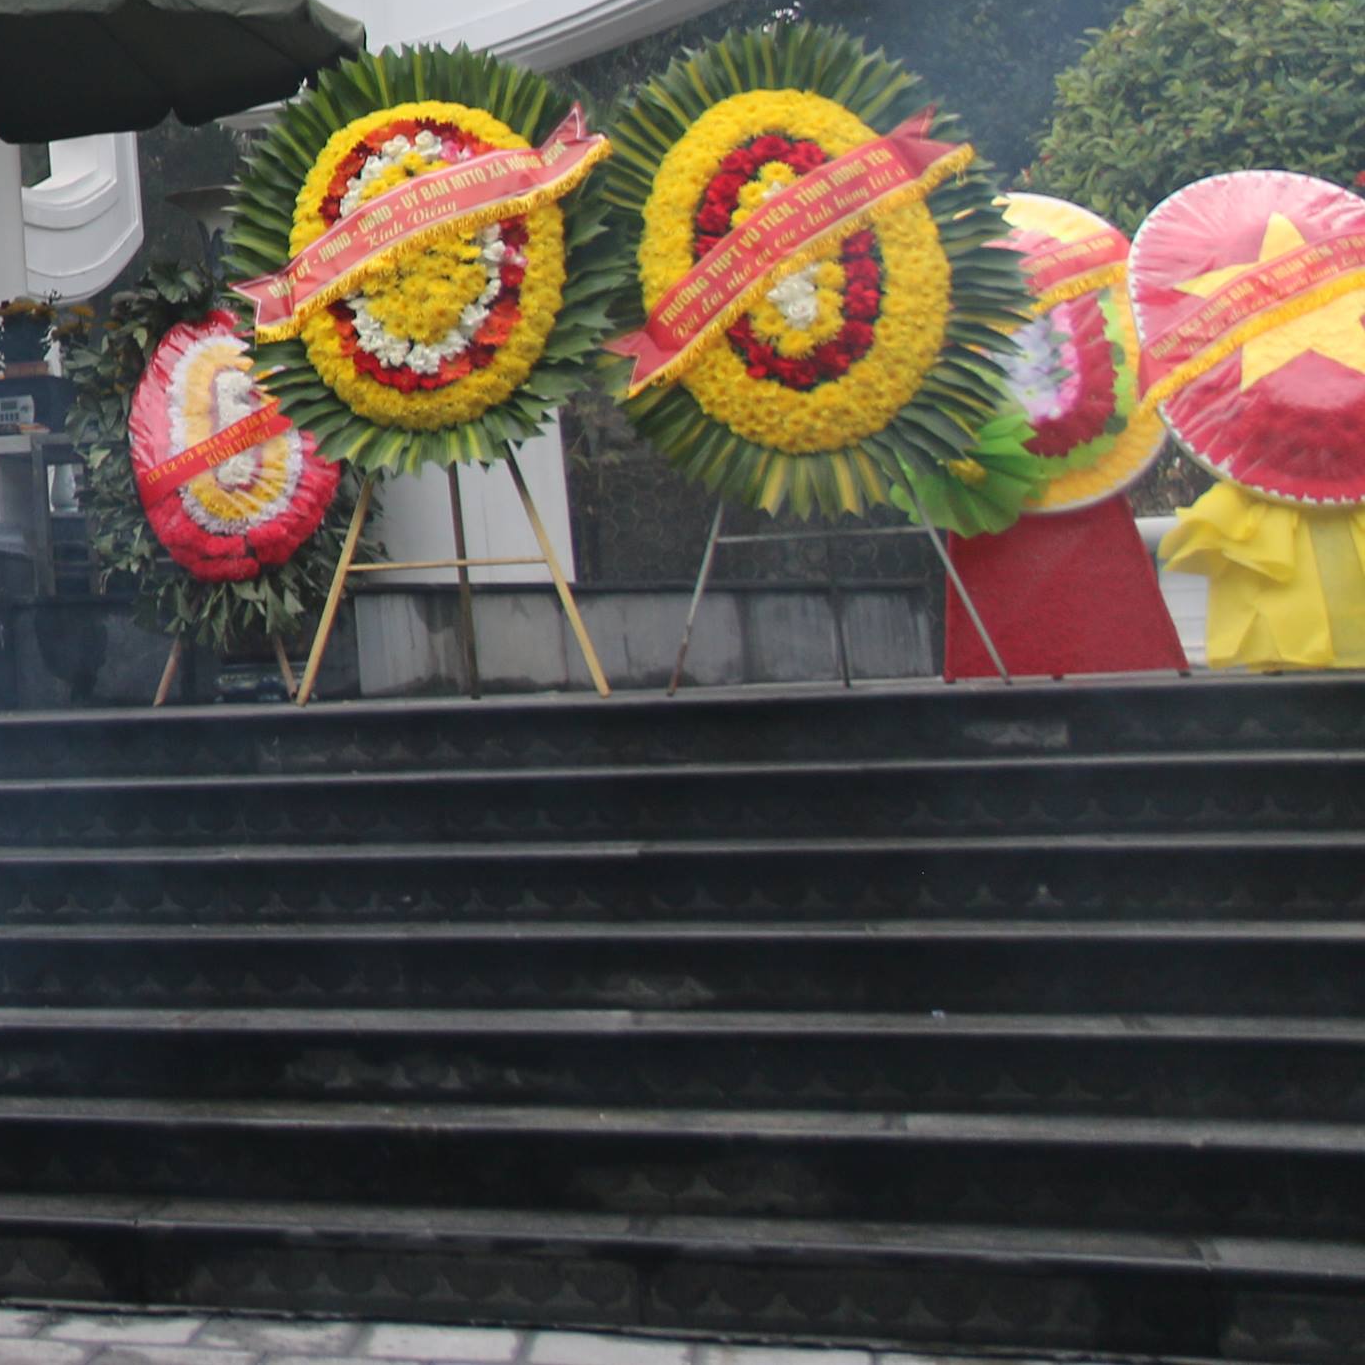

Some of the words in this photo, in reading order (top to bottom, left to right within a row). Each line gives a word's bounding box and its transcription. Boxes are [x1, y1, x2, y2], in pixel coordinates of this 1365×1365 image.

[419, 178, 451, 202] BAN
[449, 167, 488, 192] MTTQ
[705, 245, 743, 278] THPT
